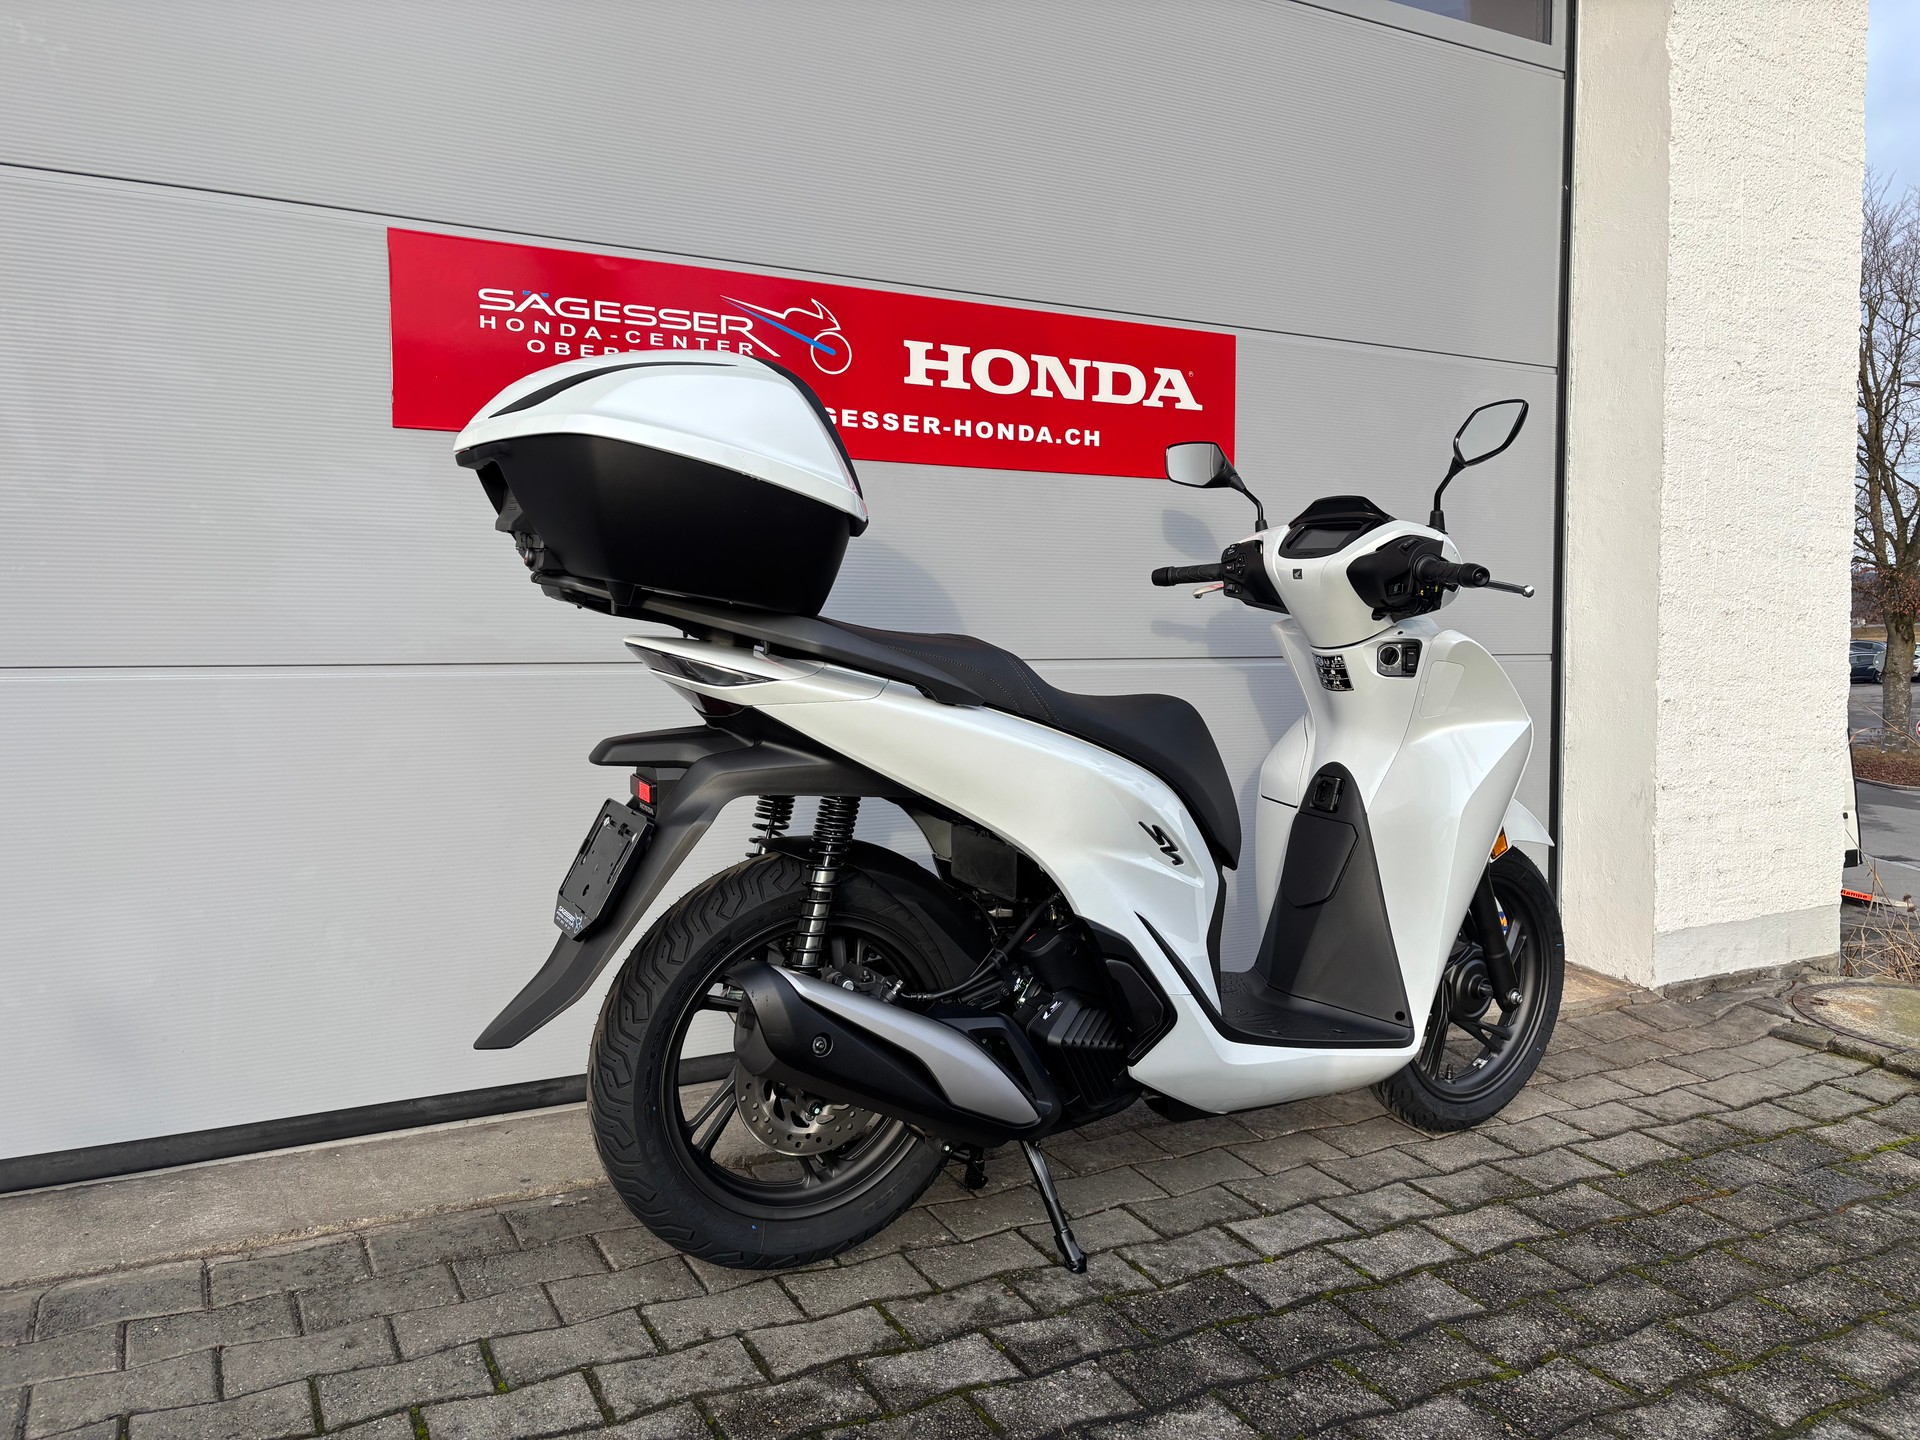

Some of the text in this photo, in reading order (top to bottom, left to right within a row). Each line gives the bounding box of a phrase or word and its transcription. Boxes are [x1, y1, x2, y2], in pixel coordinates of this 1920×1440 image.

[477, 288, 780, 357] SÄGESSER
[479, 314, 754, 355] HONDA-CENTER
[903, 340, 1203, 411] HONDA
